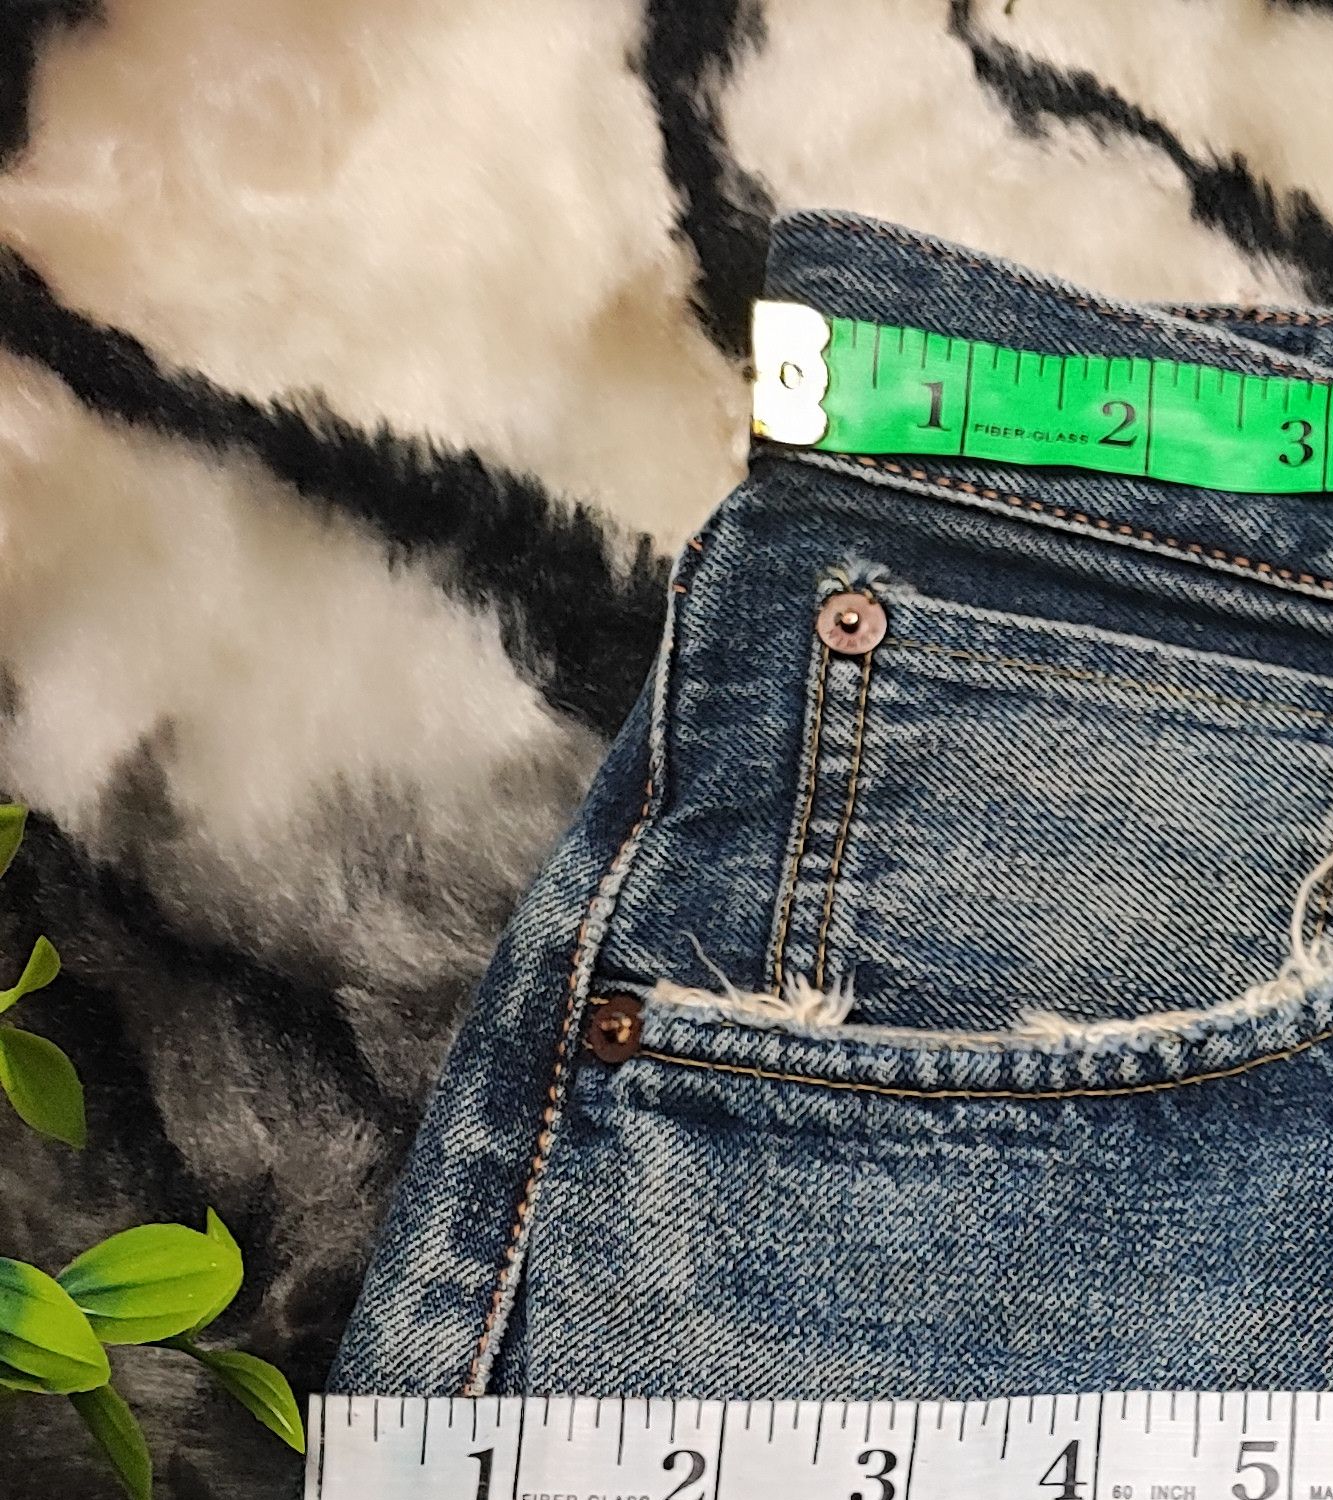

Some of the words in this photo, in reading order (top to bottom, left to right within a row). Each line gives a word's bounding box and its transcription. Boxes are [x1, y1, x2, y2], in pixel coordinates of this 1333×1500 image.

[917, 381, 953, 432] 1
[1099, 401, 1138, 447] 2
[1278, 419, 1315, 468] 3
[973, 423, 1089, 445] FIBER-GLASS
[1038, 1439, 1088, 1500] 4
